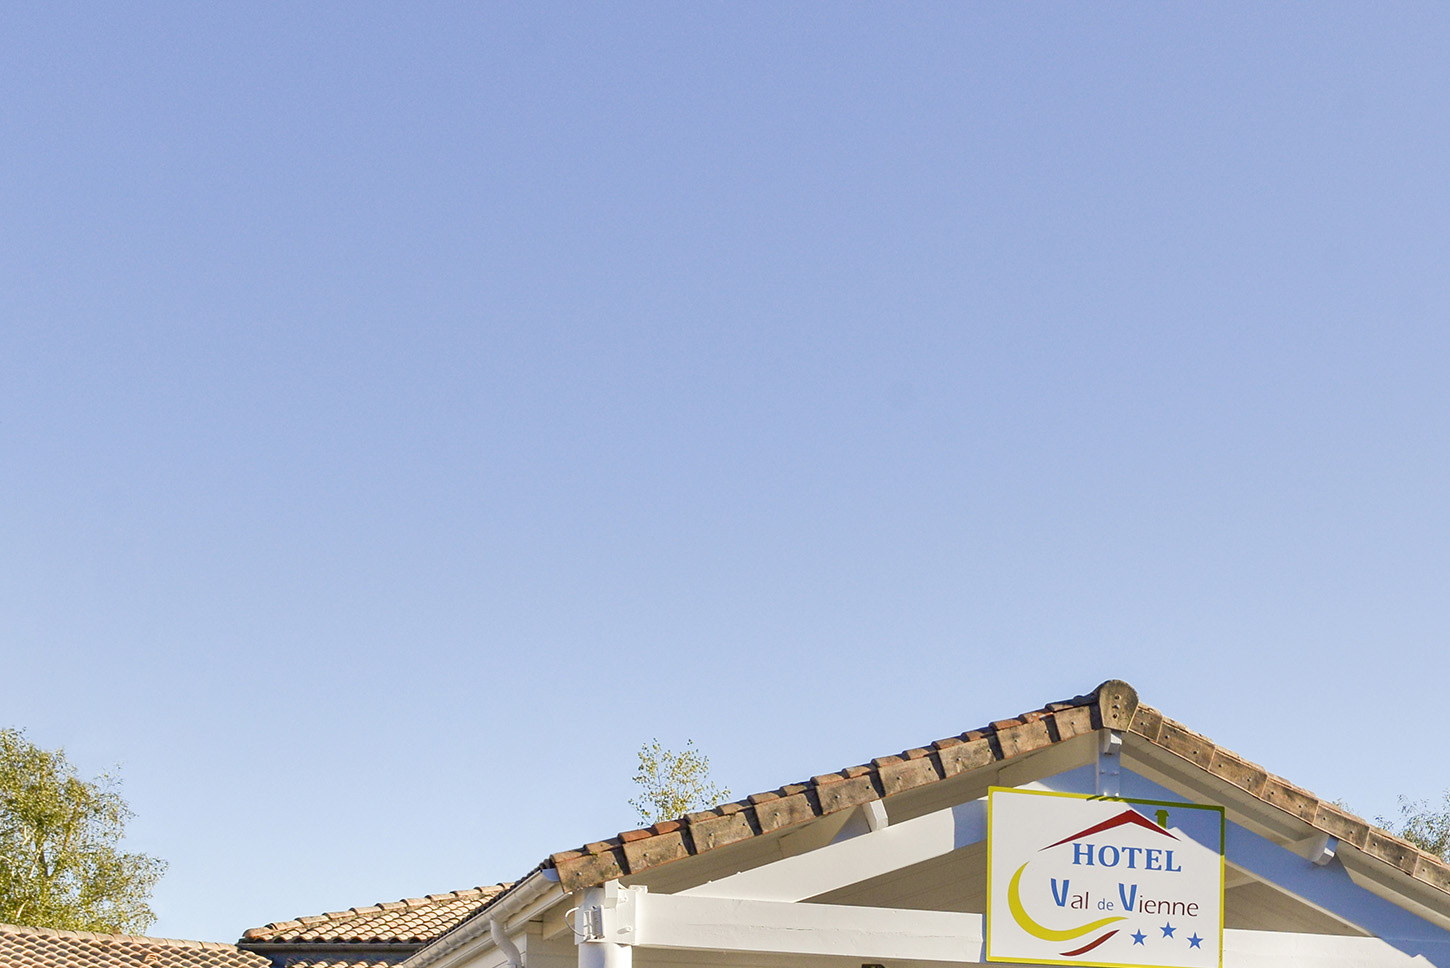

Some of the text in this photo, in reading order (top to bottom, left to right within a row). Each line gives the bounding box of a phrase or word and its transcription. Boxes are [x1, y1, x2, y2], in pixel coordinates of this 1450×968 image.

[1072, 842, 1182, 873] HOTEL
[1050, 877, 1200, 917] Val de Vienne
